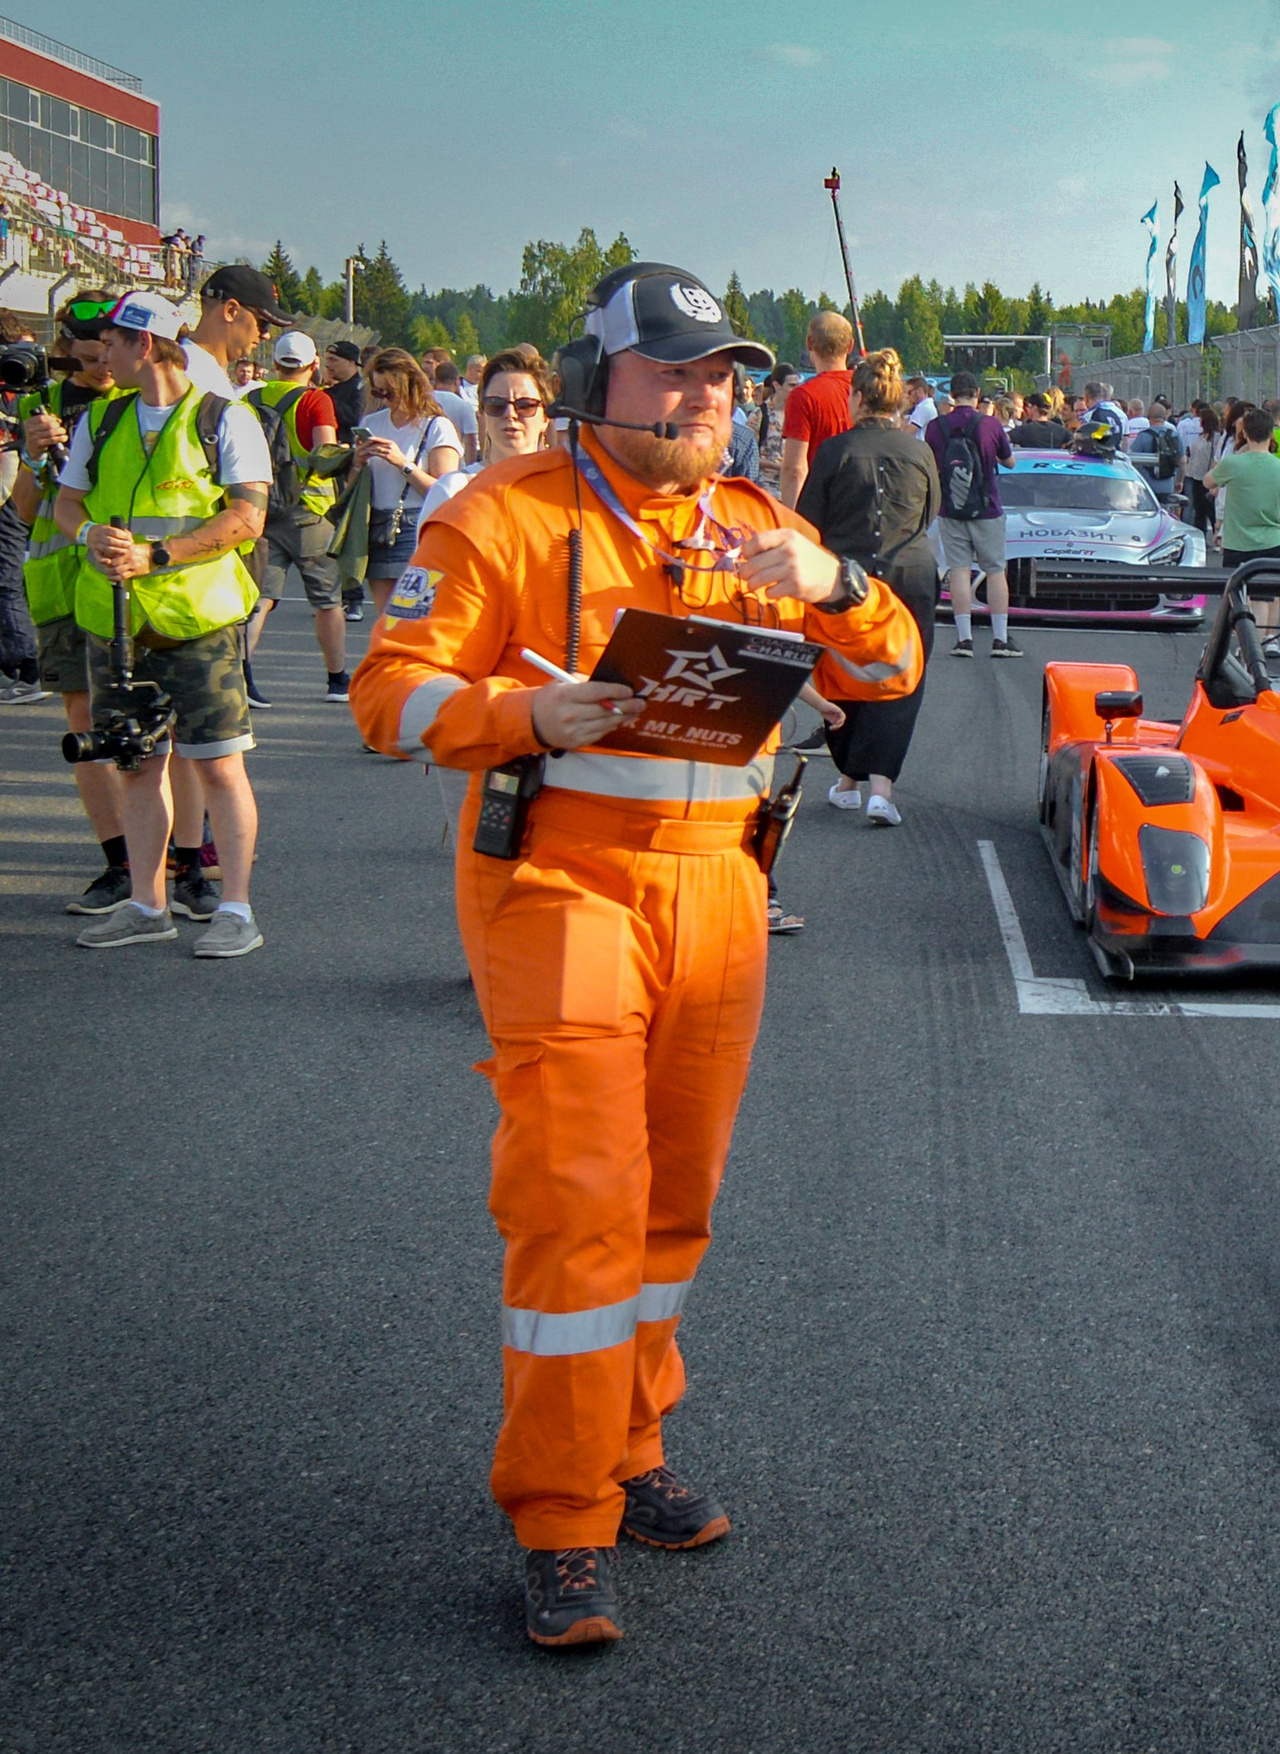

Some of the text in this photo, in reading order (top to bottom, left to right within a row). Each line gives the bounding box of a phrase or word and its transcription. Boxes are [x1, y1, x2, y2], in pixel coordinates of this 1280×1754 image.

[949, 466, 973, 510] NIKE
[1020, 529, 1118, 541] НОБАЗИТ
[745, 644, 816, 664] CHARLIE
[644, 720, 682, 735] MY
[685, 726, 743, 745] NUTS
